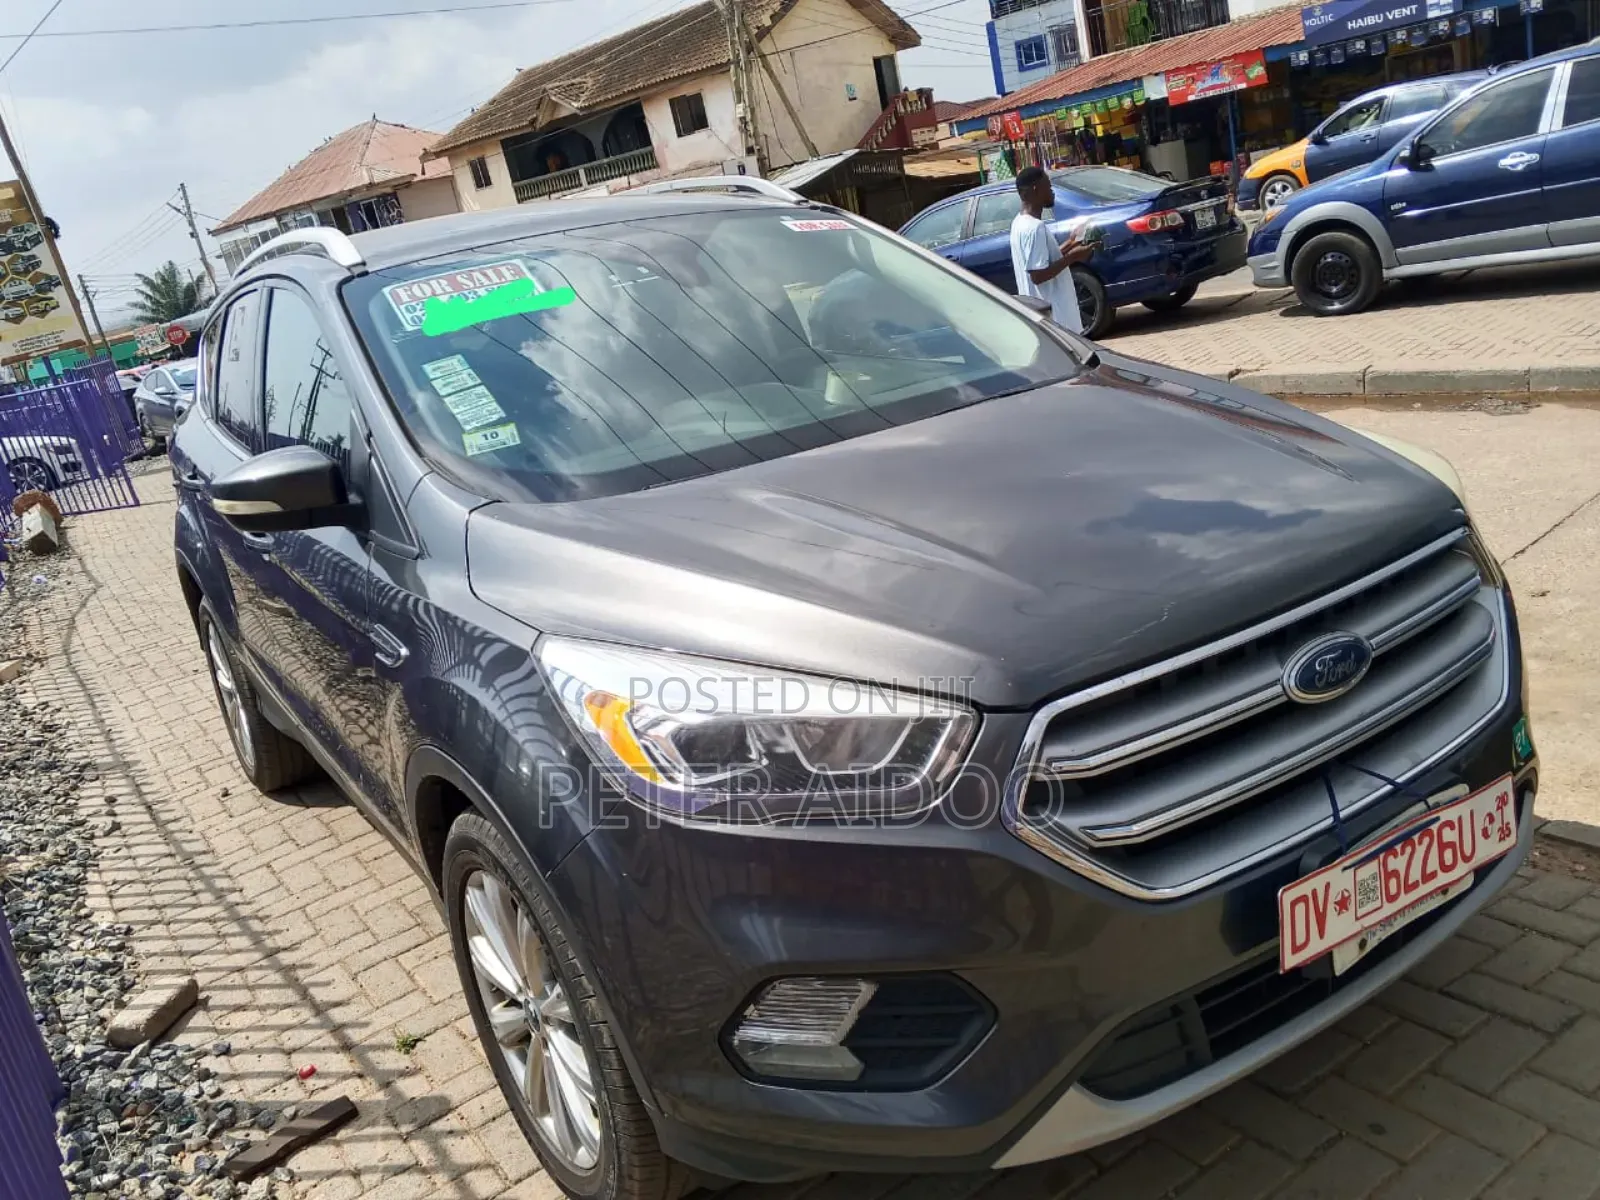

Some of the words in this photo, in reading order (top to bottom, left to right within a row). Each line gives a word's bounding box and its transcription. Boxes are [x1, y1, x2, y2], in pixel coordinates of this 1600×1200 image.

[1304, 13, 1335, 27] VOLTIC
[1347, 13, 1384, 30] HAIBU
[1385, 4, 1418, 20] VENT
[395, 278, 453, 303] FOR
[456, 265, 520, 289] SALE
[481, 430, 499, 441] 10
[1314, 649, 1357, 688] Ford
[1290, 882, 1331, 956] DV
[1382, 808, 1476, 904] 6226U
